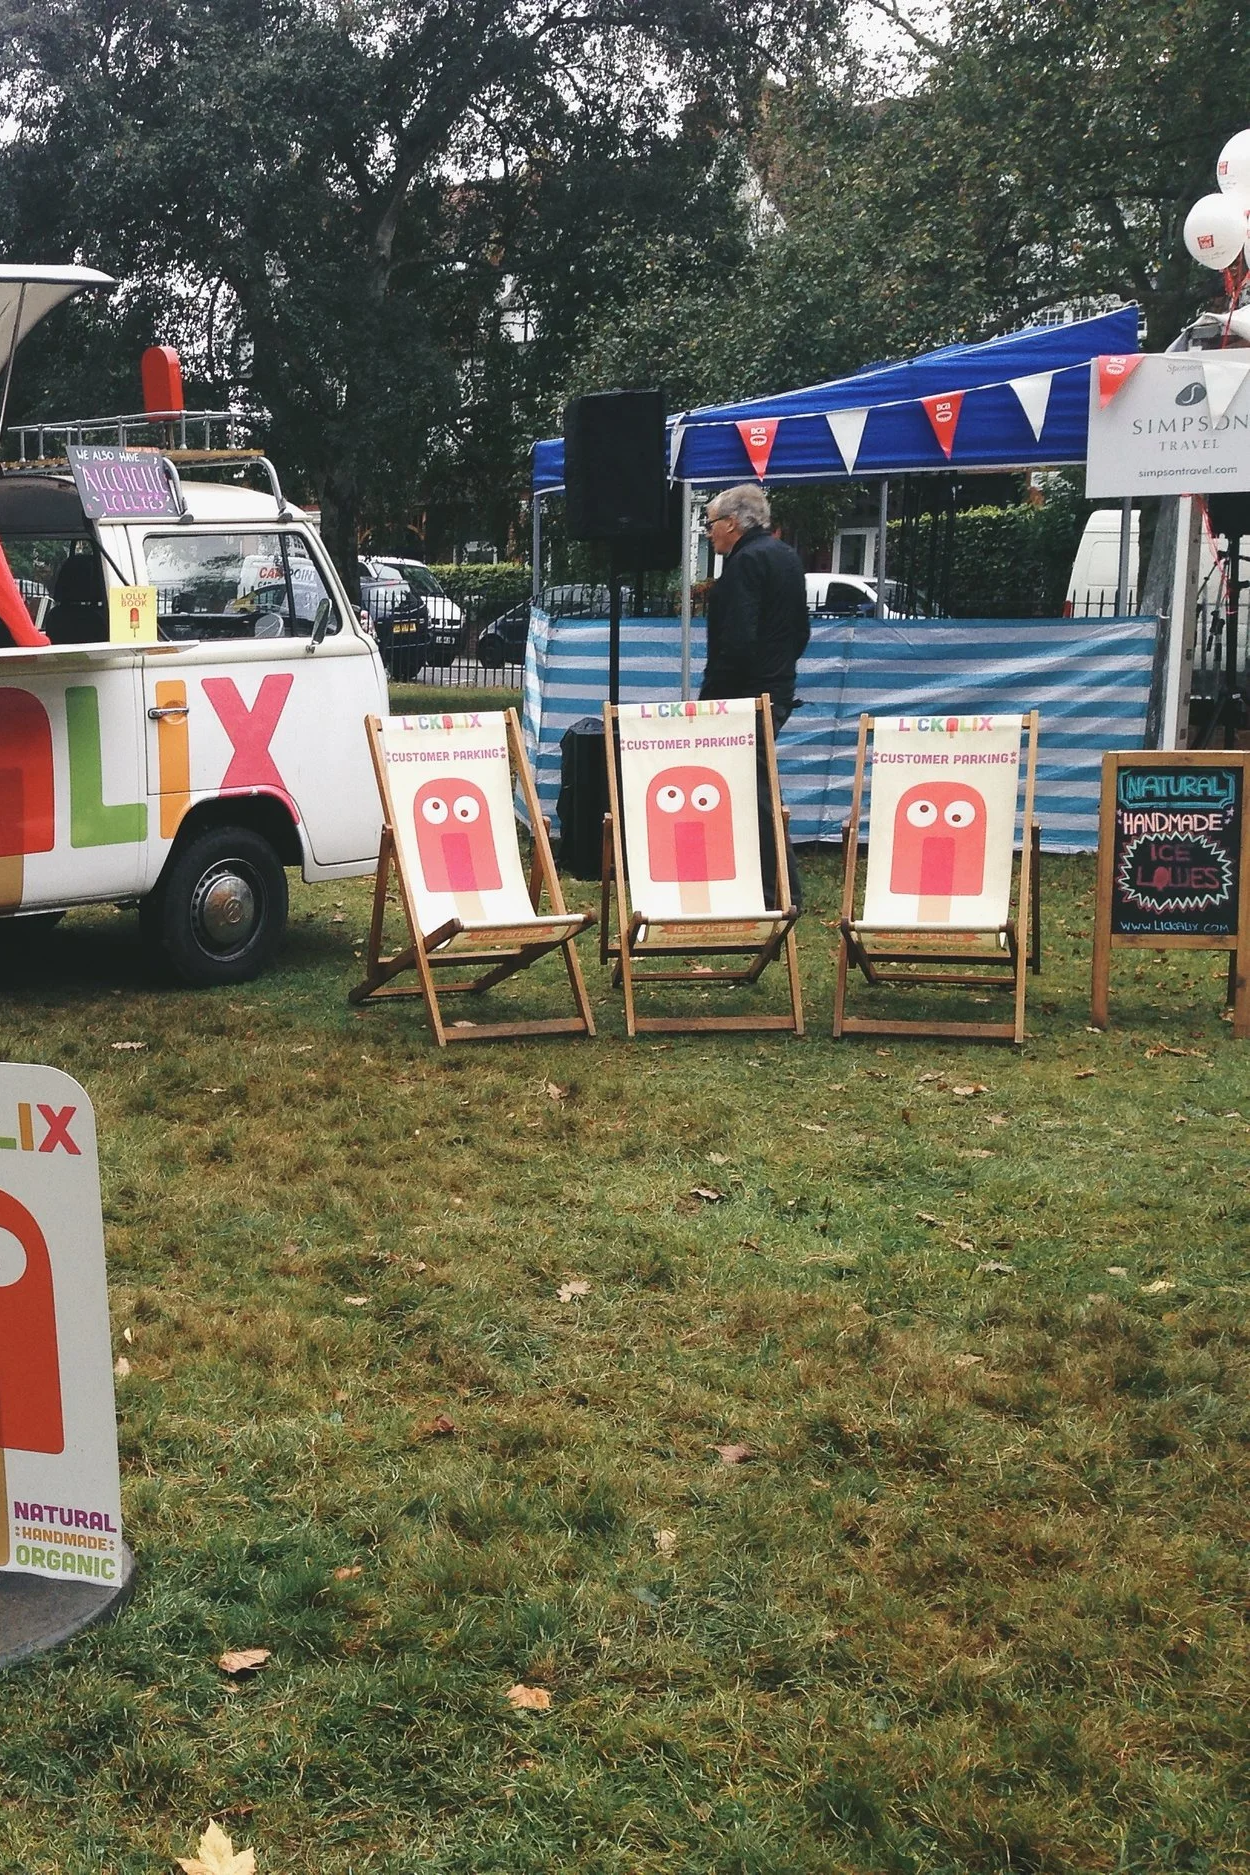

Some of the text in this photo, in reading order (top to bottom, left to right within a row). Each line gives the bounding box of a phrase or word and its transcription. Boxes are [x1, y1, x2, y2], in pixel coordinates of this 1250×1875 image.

[1132, 414, 1249, 435] SIMPSON
[1159, 439, 1219, 451] TRAVEL
[76, 449, 89, 461] WE
[92, 450, 114, 461] ALSO
[82, 465, 169, 493] ALCOHOLIC
[1138, 465, 1237, 478] simpsontravel.com
[102, 493, 163, 511] LOLLIES
[626, 735, 746, 750] CUSTOMER PARKING
[392, 748, 499, 762] CUSTOMER PARKING
[880, 753, 1009, 764] CUSTOMER PARKING
[1127, 775, 1227, 800] NATURAL
[1123, 812, 1224, 835] HANDMADE
[1150, 844, 1191, 862] ICE
[14, 1501, 117, 1533] NATURAL
[22, 1526, 108, 1551] HANDMADE
[15, 1544, 116, 1580] ORGANIC
